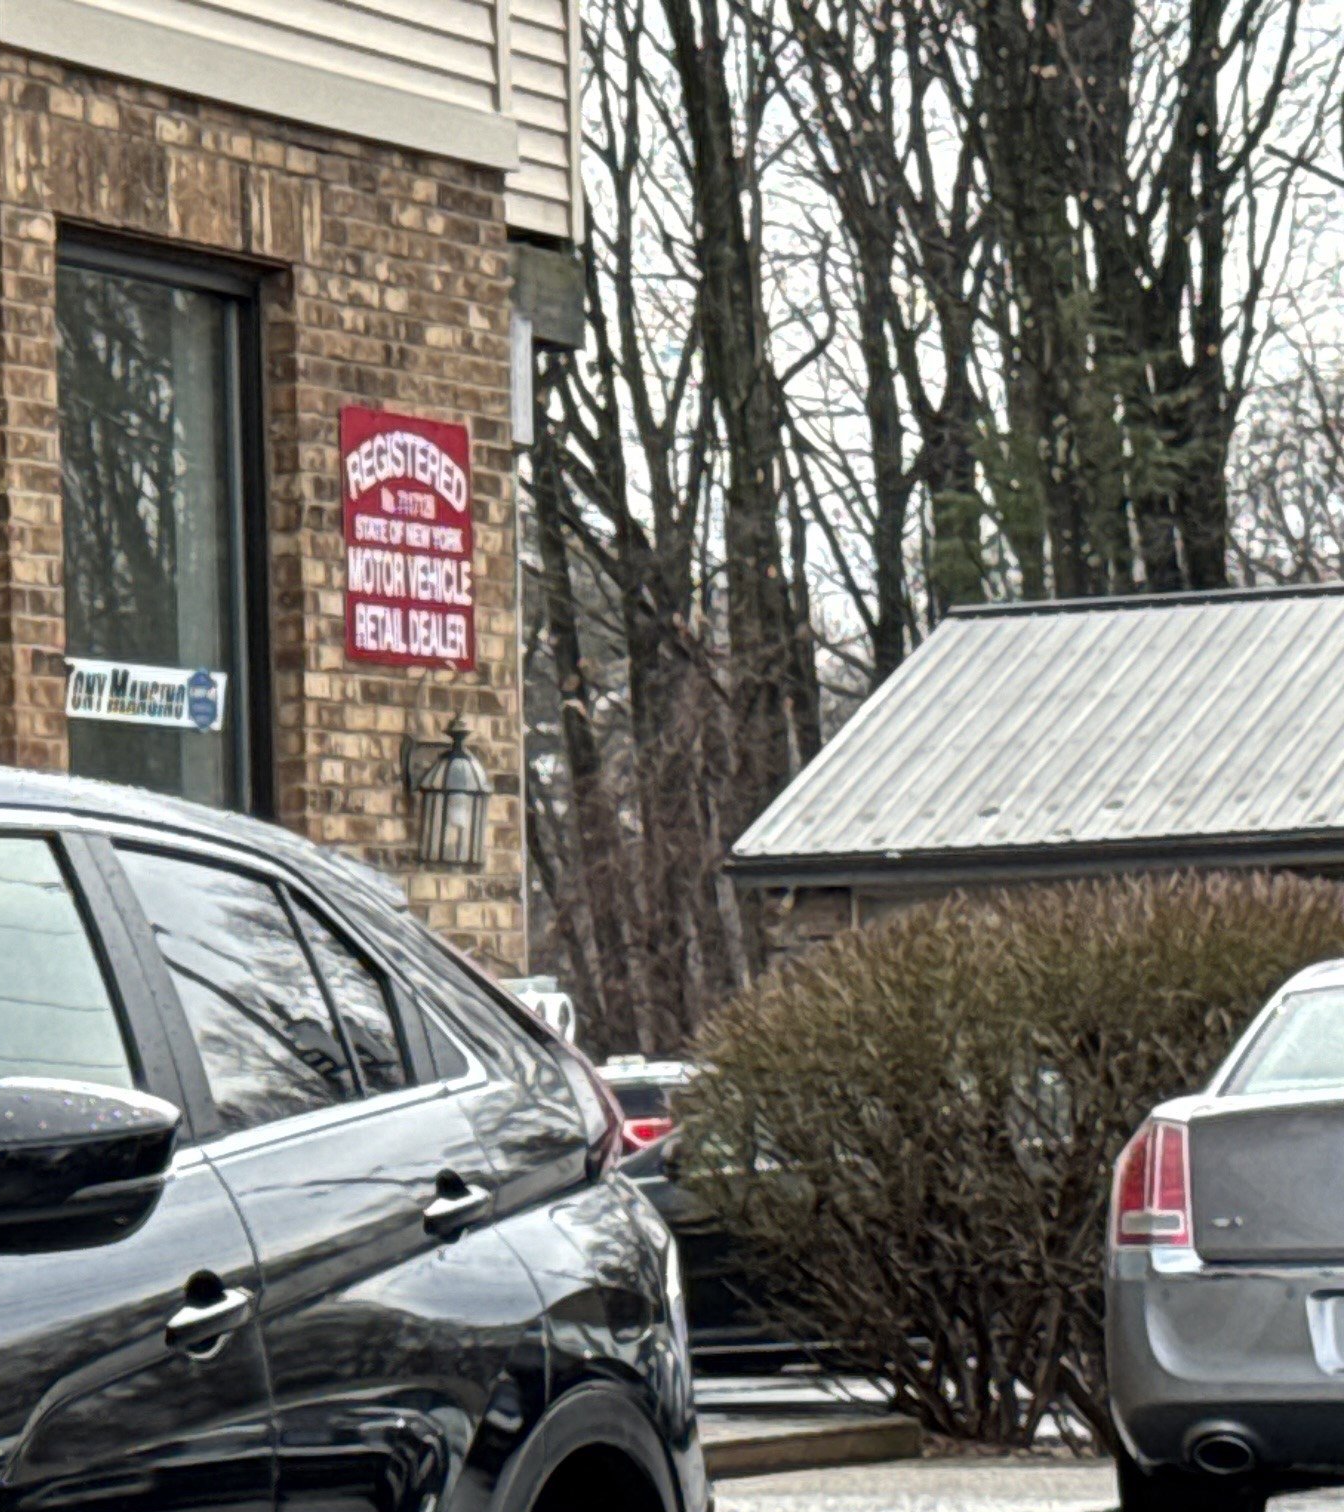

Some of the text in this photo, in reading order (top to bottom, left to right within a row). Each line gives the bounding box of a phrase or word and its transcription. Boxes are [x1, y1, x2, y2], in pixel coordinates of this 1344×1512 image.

[346, 431, 467, 512] REGISTERED
[348, 546, 472, 606] MOTOR VEHICLE
[355, 602, 468, 660] RETAIL DEALER
